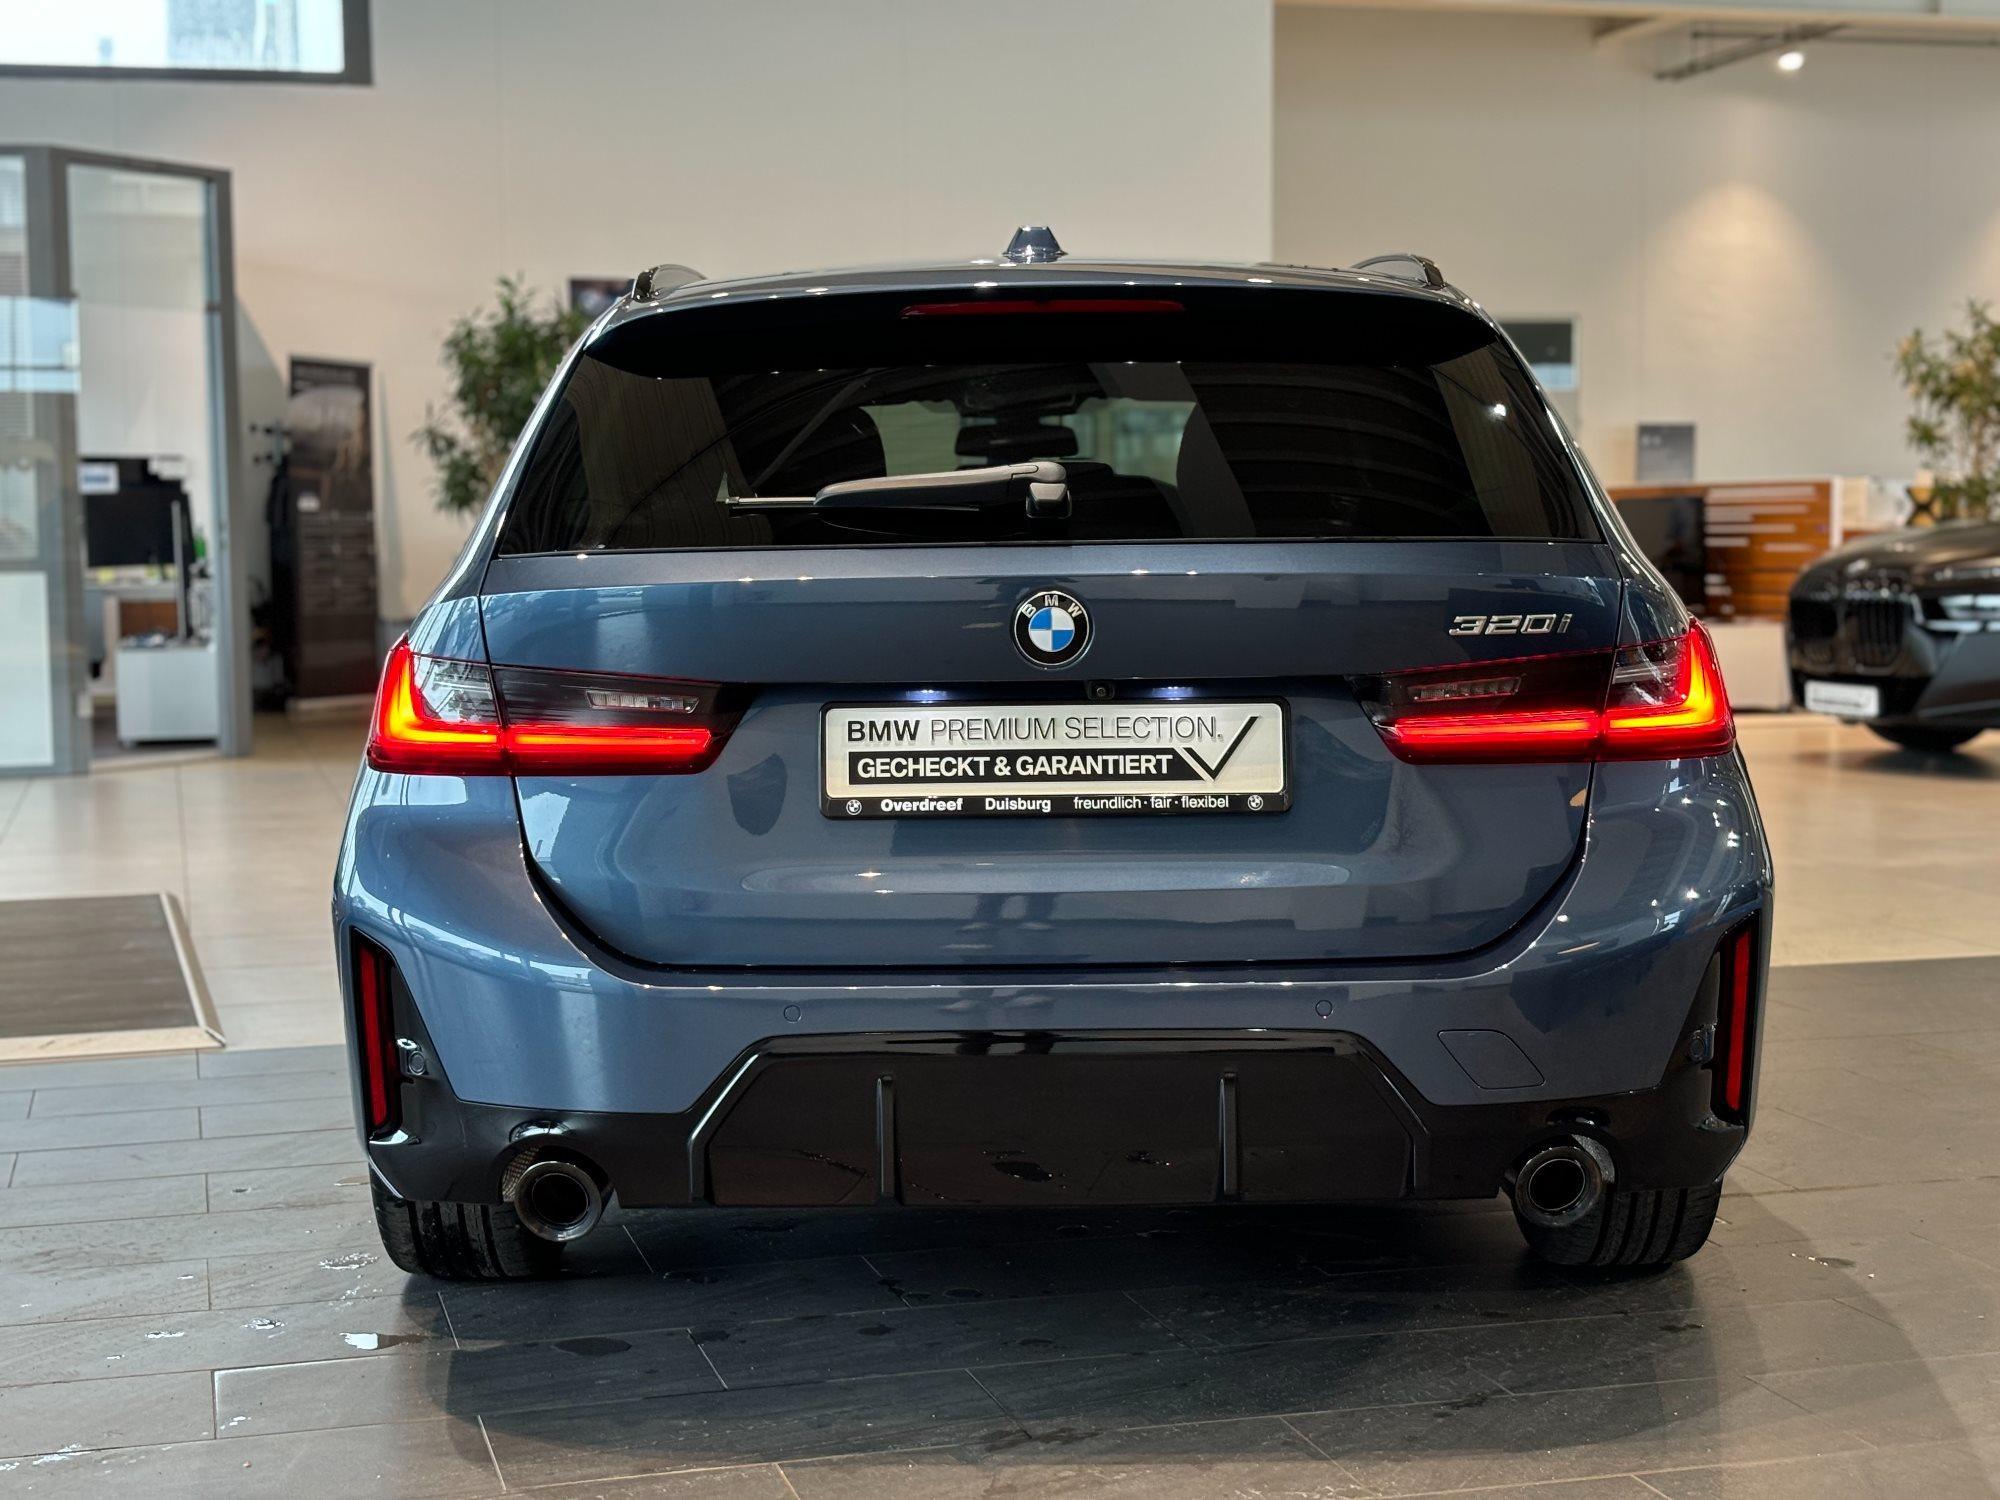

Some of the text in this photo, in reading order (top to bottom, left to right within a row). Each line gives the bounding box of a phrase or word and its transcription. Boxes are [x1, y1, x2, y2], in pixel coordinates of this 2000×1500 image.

[1021, 594, 1083, 619] BMW
[1448, 613, 1573, 636] 320i
[848, 715, 1223, 742] BMW PREMIUM SELECTION.
[857, 754, 1173, 779] GECHECKT & GARANTIERT
[880, 795, 1229, 813] Overdreef Duisburg freundlich fair flexibel
